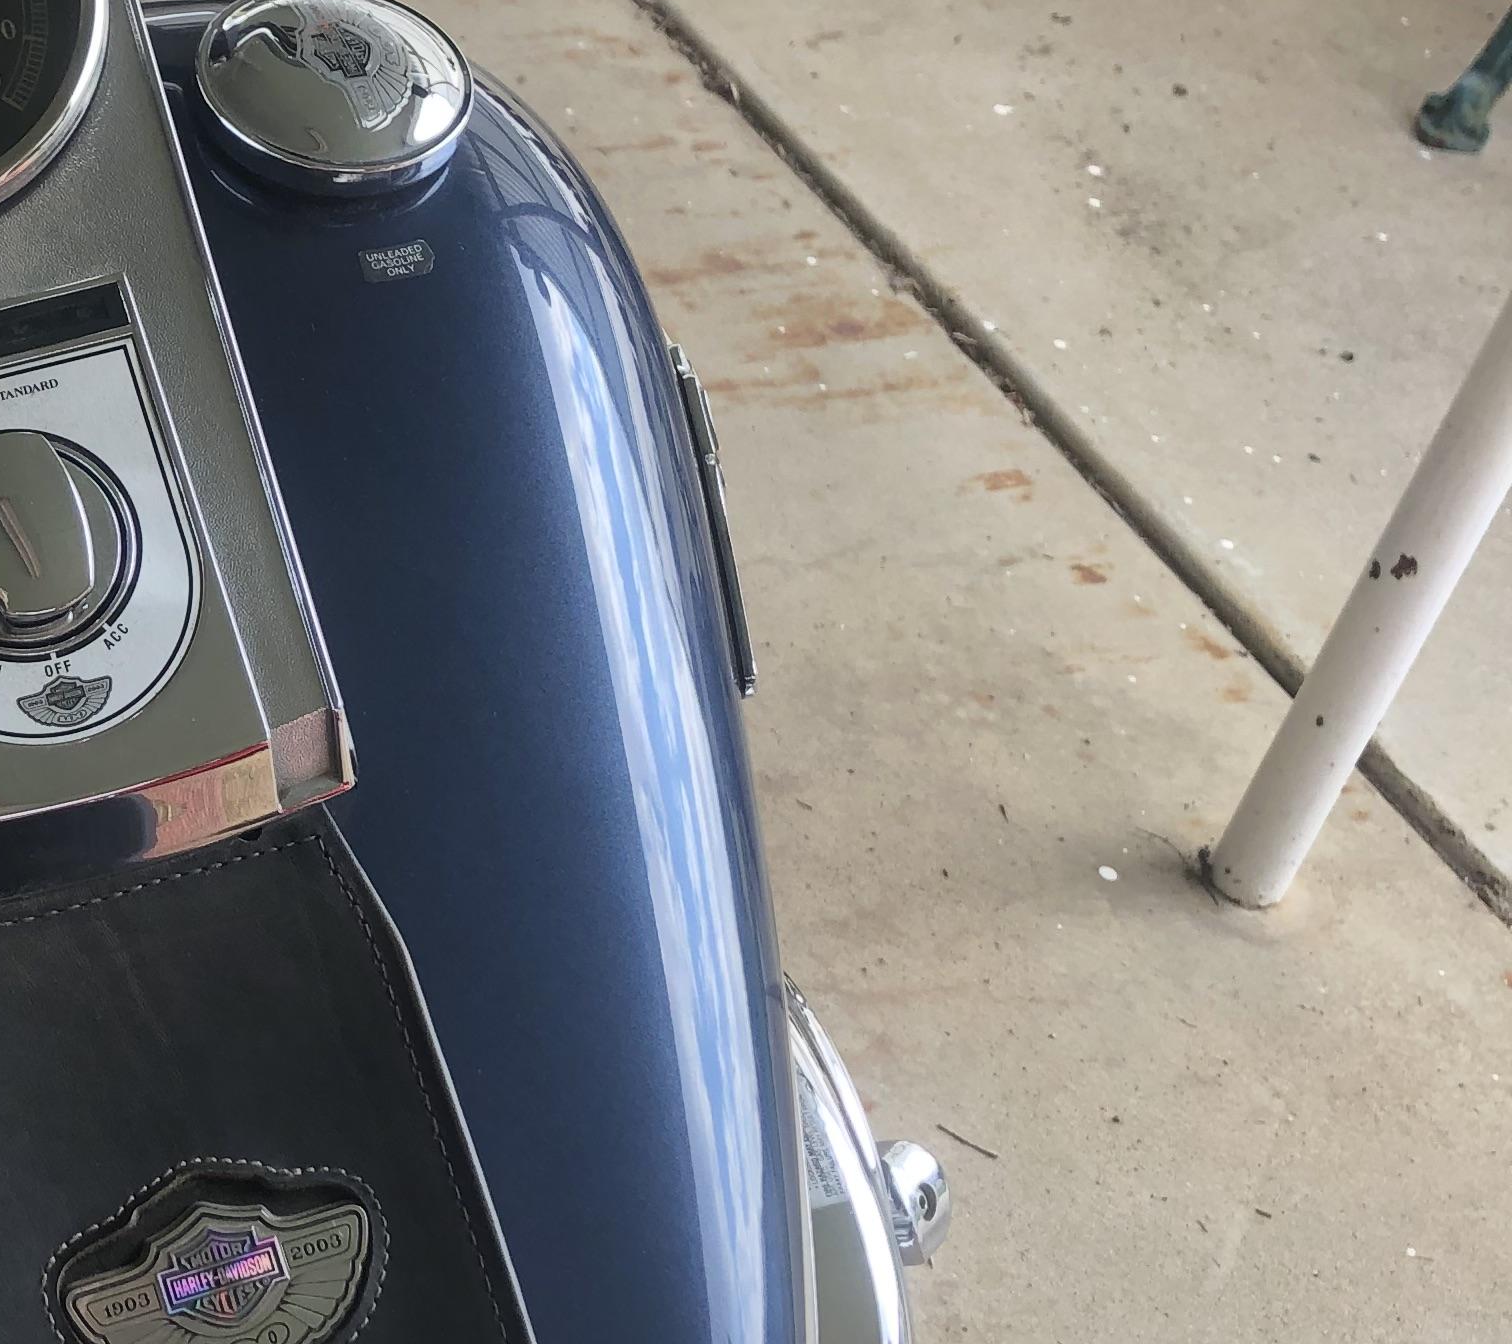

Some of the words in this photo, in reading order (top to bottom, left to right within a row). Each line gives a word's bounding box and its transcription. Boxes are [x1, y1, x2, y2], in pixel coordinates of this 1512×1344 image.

[366, 244, 422, 262] UNLEADED
[371, 253, 424, 269] GASOLINE
[387, 264, 414, 276] ONLY
[102, 621, 131, 650] ACC
[44, 659, 72, 677] OFF
[291, 1234, 342, 1259] 2003
[172, 1252, 274, 1299] HARLEY-DAVIDSON
[104, 1293, 150, 1318] 1903
